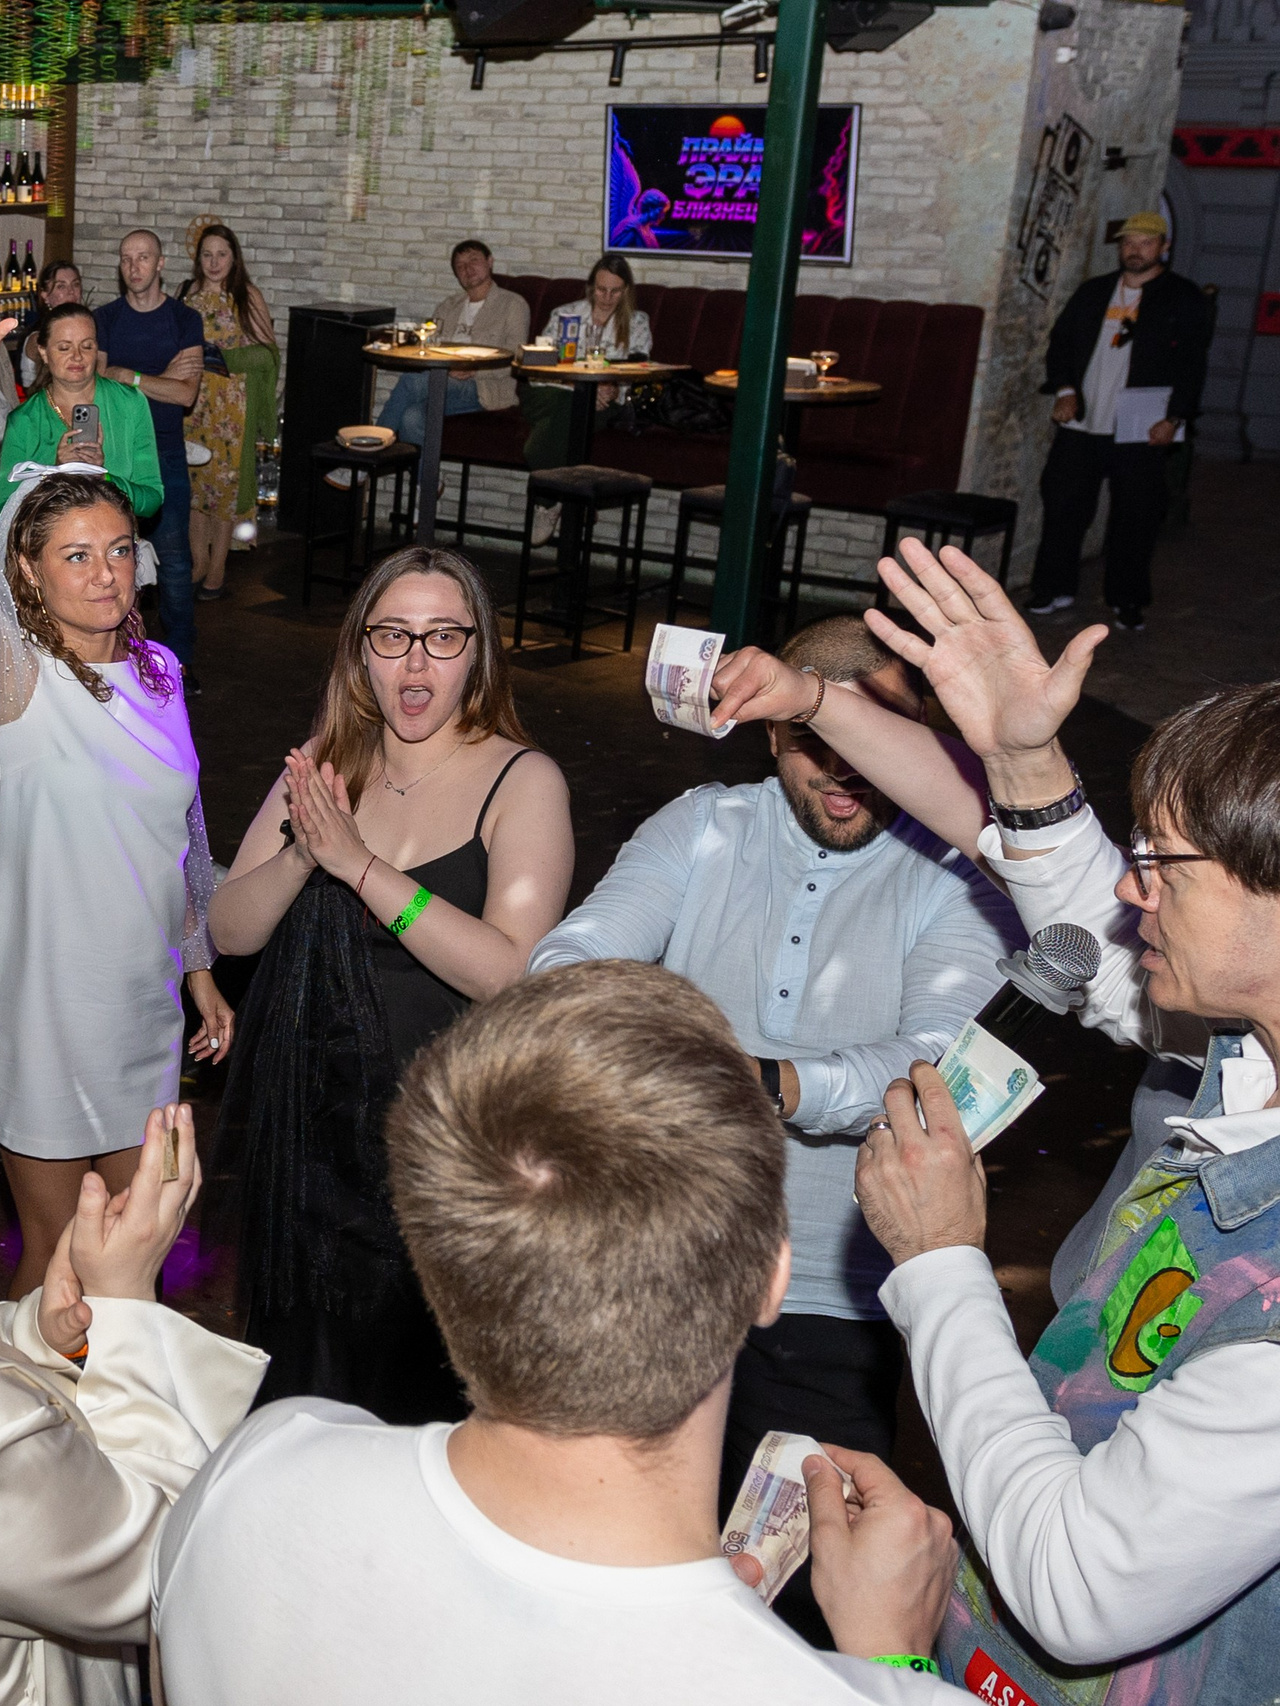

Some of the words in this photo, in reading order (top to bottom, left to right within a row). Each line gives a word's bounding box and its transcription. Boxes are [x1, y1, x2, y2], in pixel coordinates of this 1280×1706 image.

[683, 163, 762, 199] ЭРА
[672, 200, 759, 223] БЛИЗНЕЦ
[702, 638, 716, 661] 500
[741, 1473, 764, 1512] РУБЛЕЙ
[723, 1530, 751, 1558] 50
